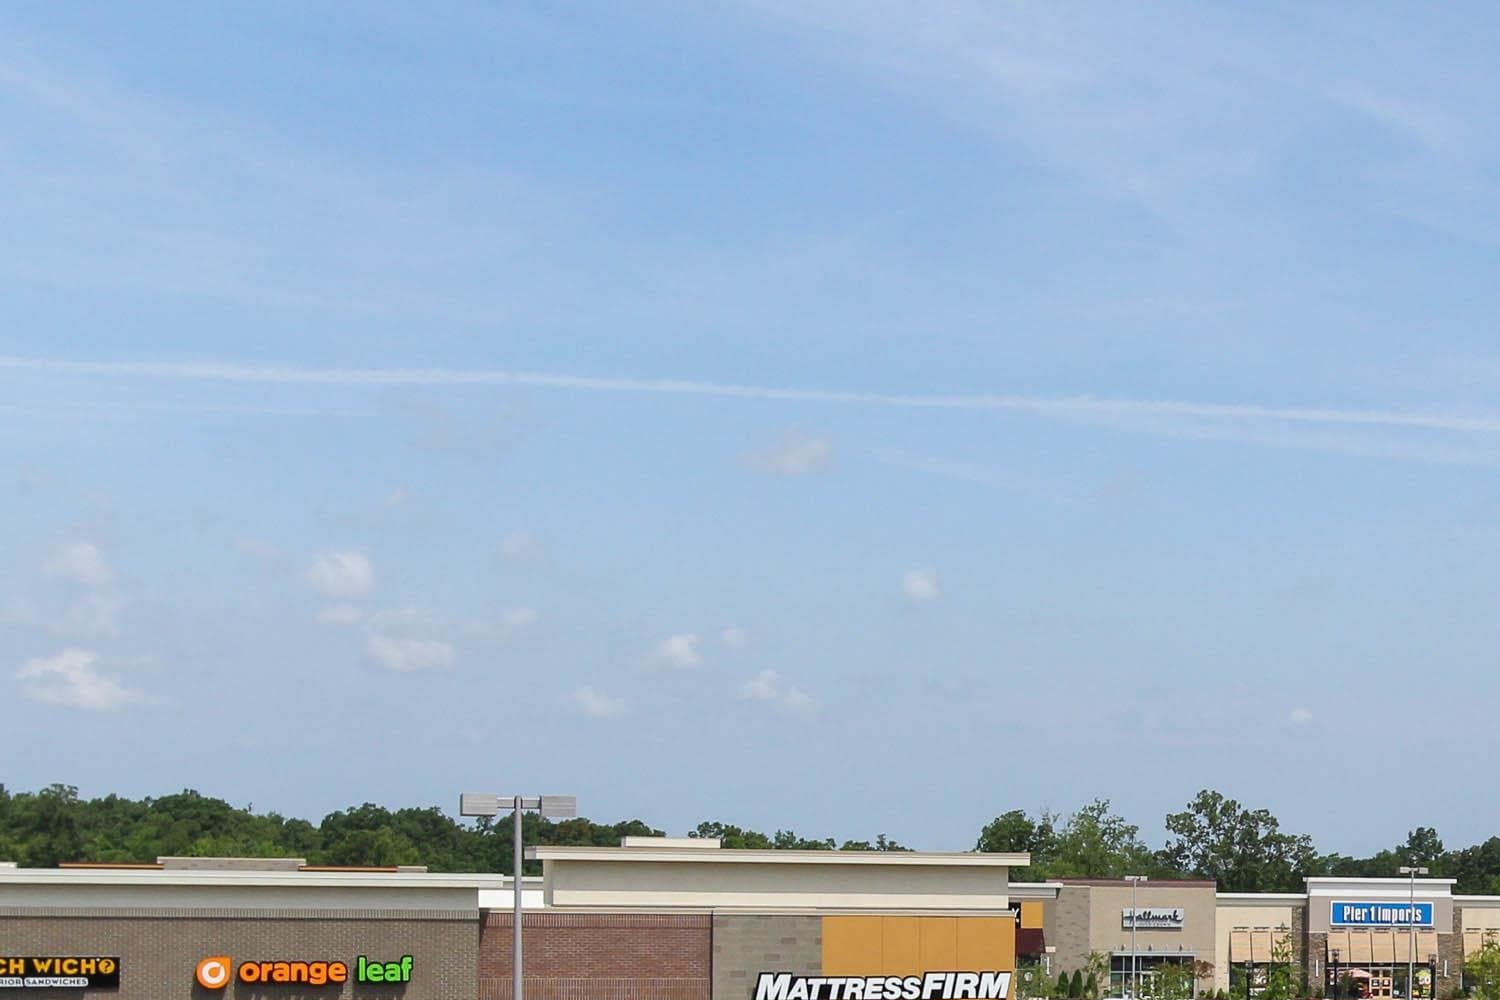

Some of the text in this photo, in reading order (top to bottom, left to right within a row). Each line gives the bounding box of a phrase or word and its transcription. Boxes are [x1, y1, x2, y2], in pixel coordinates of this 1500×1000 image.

[1123, 909, 1183, 925] Hallmark
[1343, 905, 1368, 921] Pier
[1369, 905, 1376, 921] 1
[239, 956, 412, 985] orange leaf
[25, 978, 88, 986] SANDWICHES
